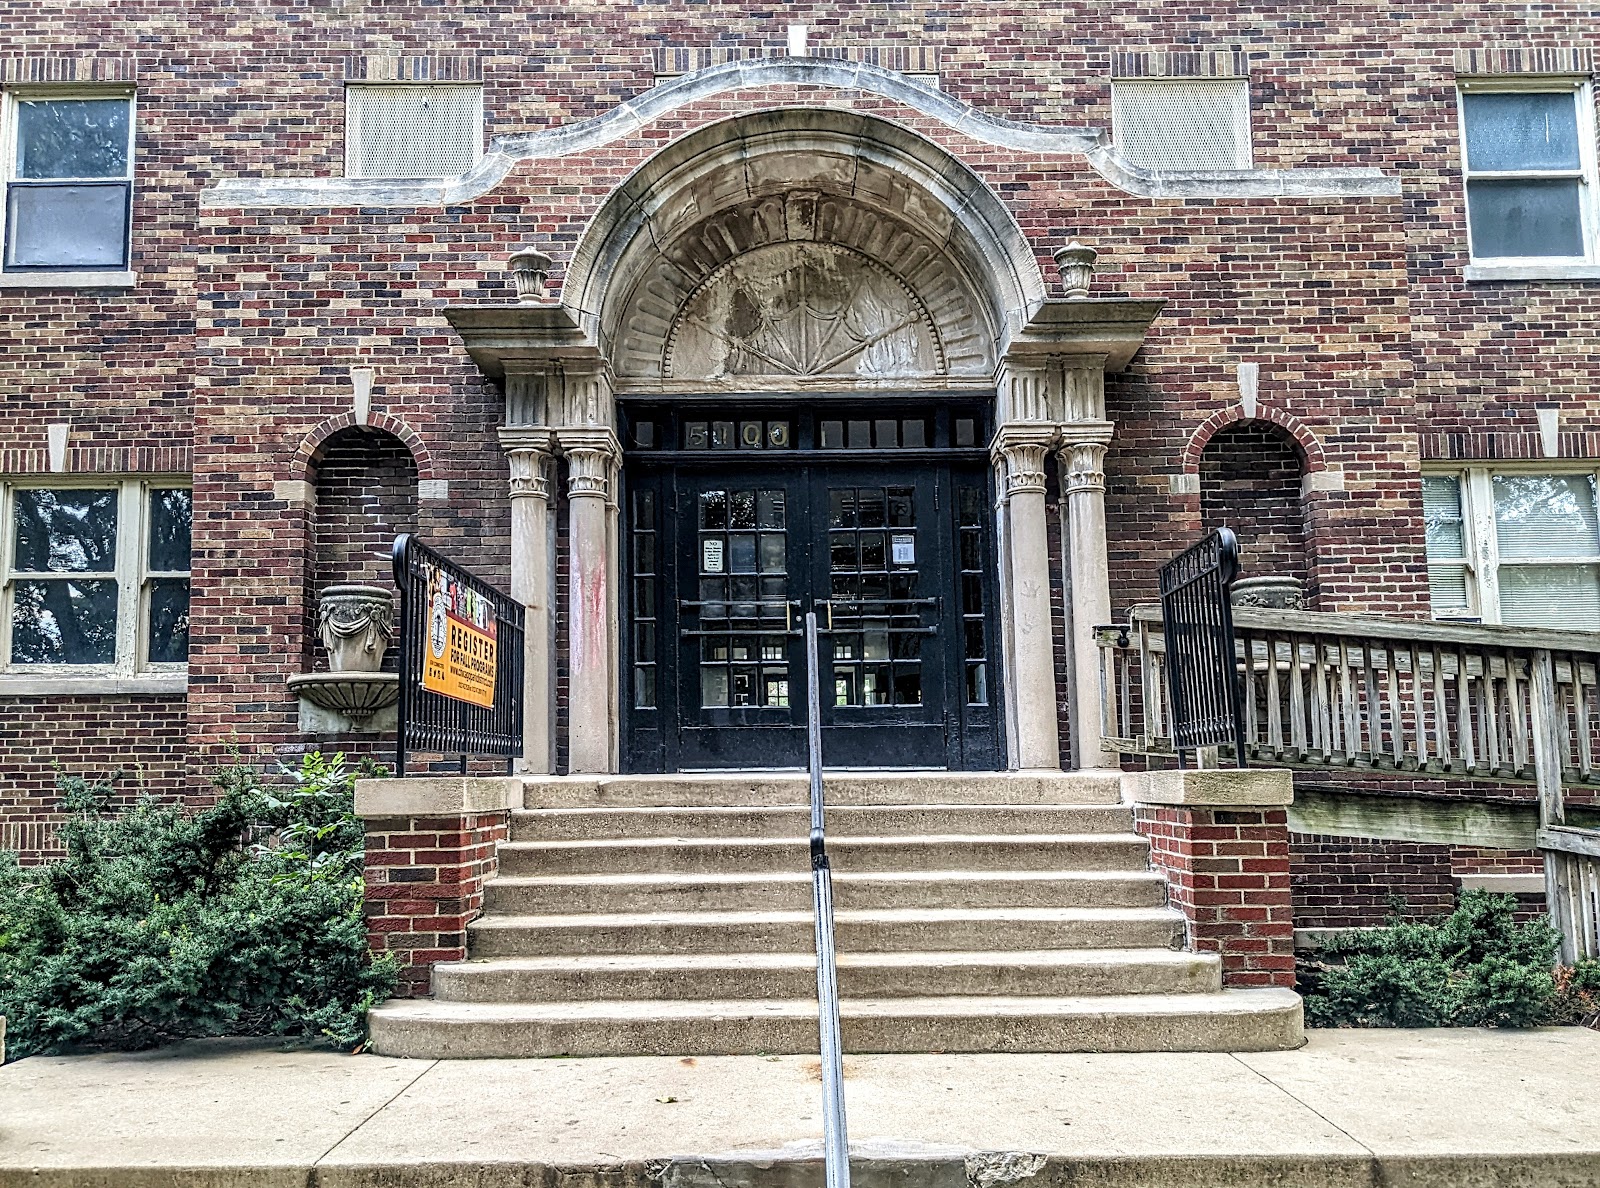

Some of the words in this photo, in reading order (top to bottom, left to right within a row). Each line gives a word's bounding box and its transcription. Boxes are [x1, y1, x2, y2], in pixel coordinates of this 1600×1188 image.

[690, 424, 787, 445] 5100
[451, 624, 494, 664] REGISTER
[450, 648, 460, 664] FOR
[460, 652, 471, 669] FALL
[471, 657, 494, 678] PROGRAMS
